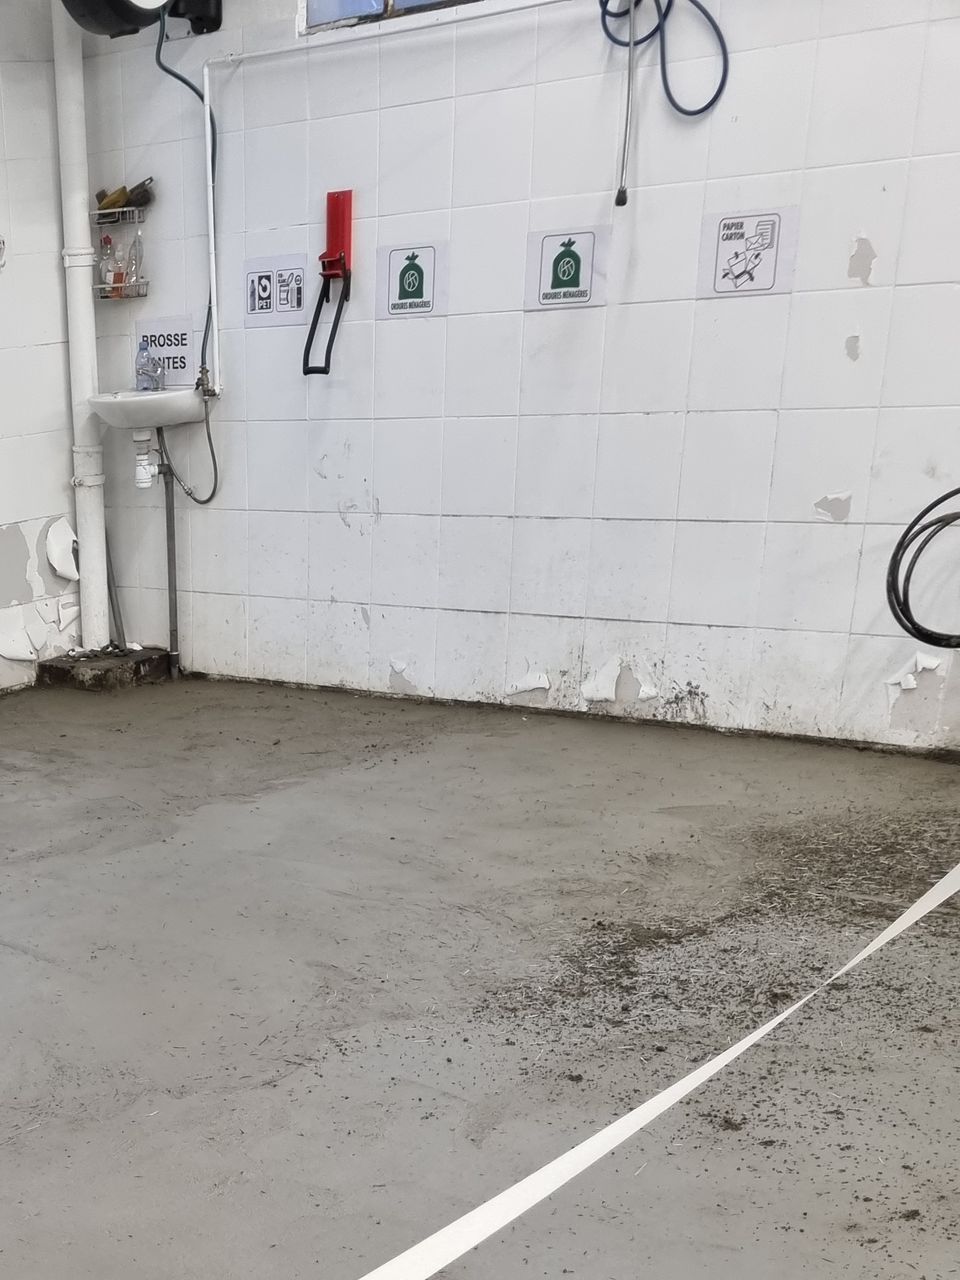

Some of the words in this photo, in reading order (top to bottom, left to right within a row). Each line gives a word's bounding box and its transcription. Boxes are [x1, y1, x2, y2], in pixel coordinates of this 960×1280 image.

[722, 221, 744, 231] PAPIER
[721, 231, 745, 241] CARTON
[258, 299, 271, 309] PET
